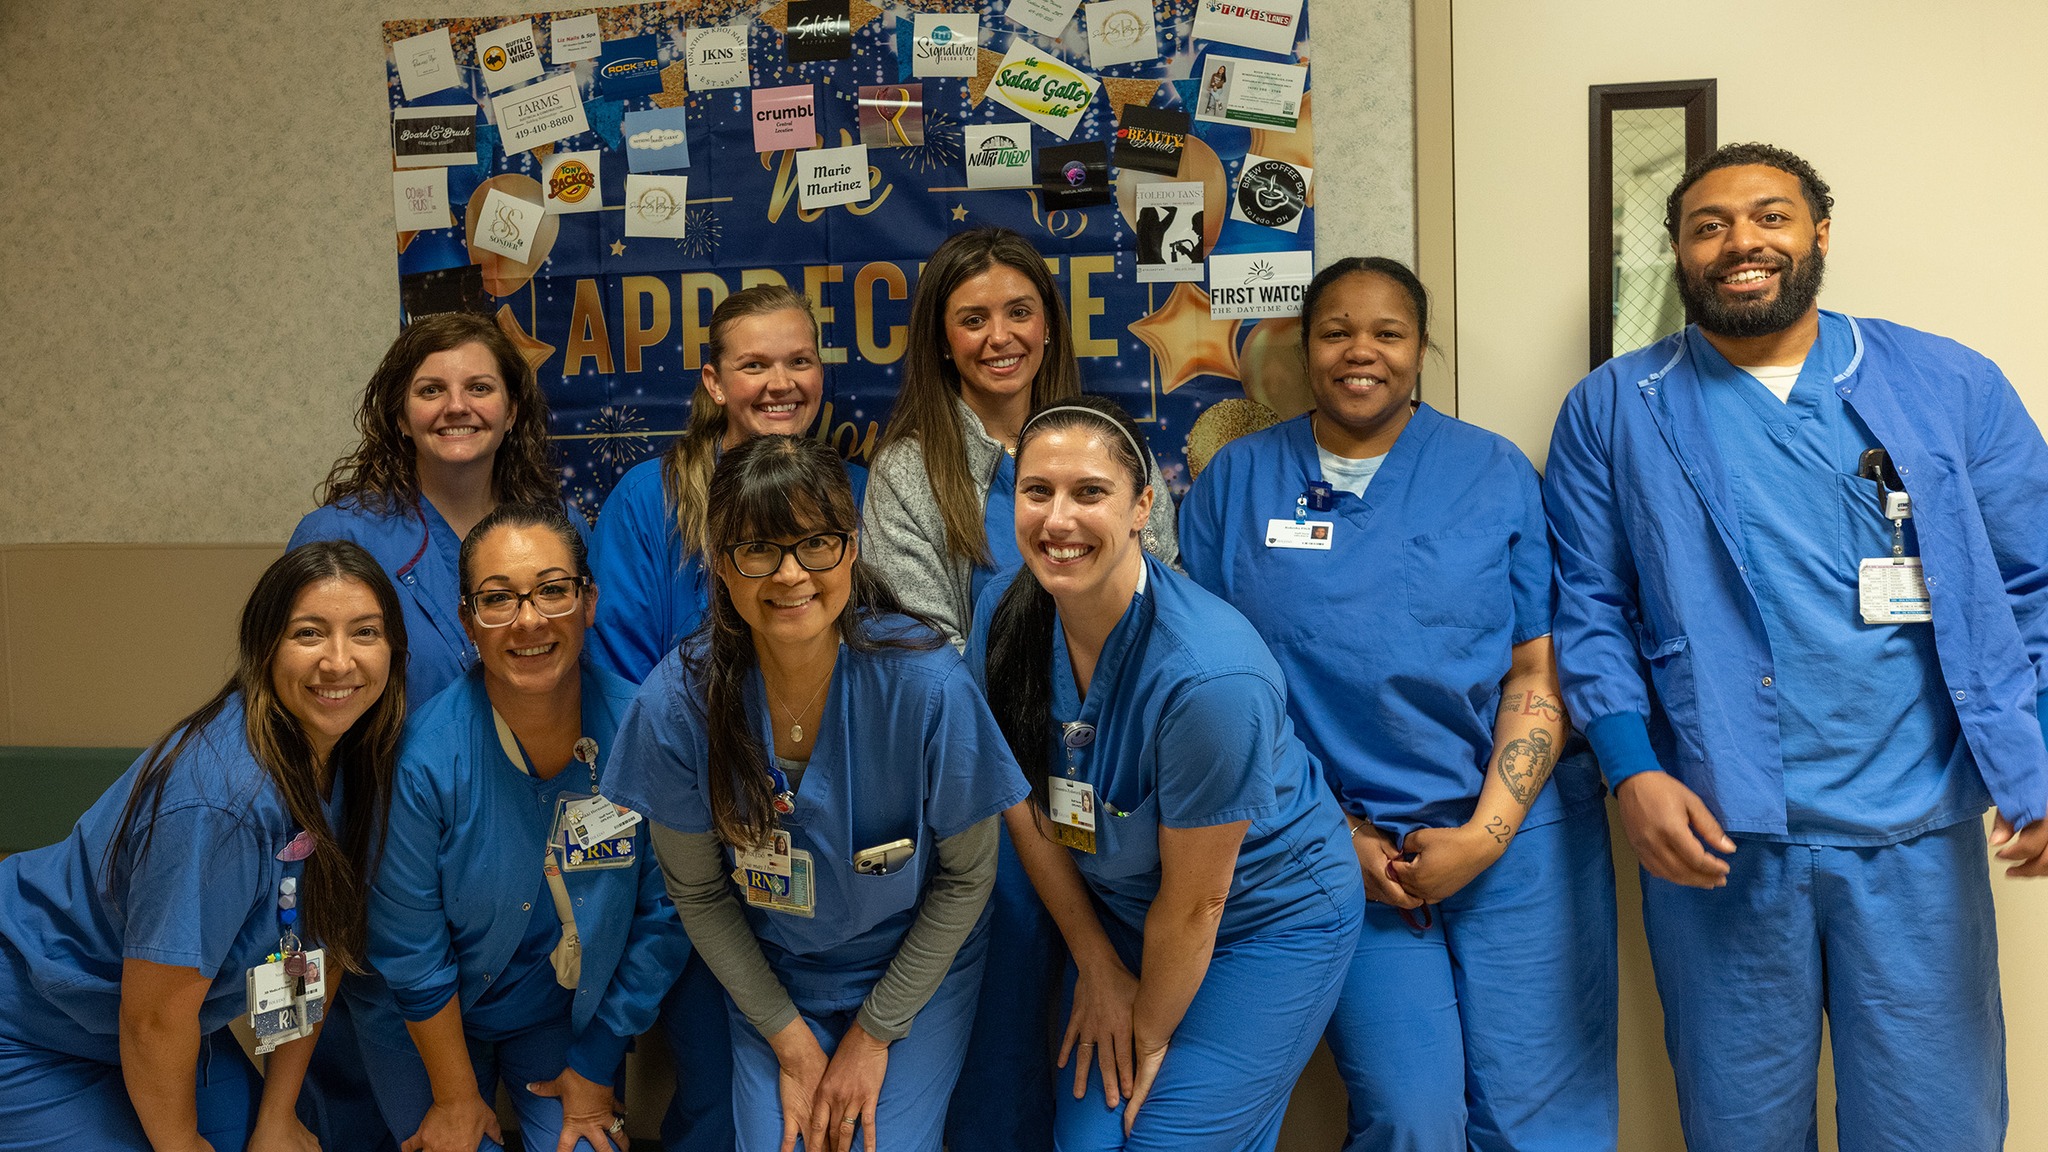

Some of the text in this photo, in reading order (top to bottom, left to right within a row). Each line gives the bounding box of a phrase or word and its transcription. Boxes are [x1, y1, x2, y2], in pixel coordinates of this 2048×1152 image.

[1216, 2, 1266, 20] STRIKES
[796, 14, 842, 39] Salute!
[505, 35, 532, 49] BUFFALO
[507, 41, 533, 57] WILD
[916, 36, 976, 65] Signature
[509, 50, 535, 64] WINGS
[702, 47, 733, 63] JKNS
[1024, 56, 1039, 68] the
[607, 59, 659, 74] ROCKETS
[996, 69, 1093, 108] Salad Galley
[518, 94, 560, 116] JARMS
[756, 104, 814, 122] crumbl
[400, 129, 430, 141] Board
[442, 126, 471, 139] Brush
[515, 114, 574, 140] 419-410-8880
[1127, 128, 1184, 148] BEAUTY
[560, 165, 582, 175] TONY
[813, 163, 852, 179] Mario
[806, 178, 862, 197] Martinez
[1241, 162, 1305, 201] BREW COFFEE BAR
[1276, 215, 1289, 224] OH
[489, 235, 519, 251] SONDER
[1211, 284, 1310, 305] FIRST WATCH
[1211, 306, 1232, 314] THE
[1237, 304, 1282, 313] DAYTIME
[587, 841, 614, 859] RN
[752, 871, 773, 891] RN
[279, 1006, 300, 1030] RN
